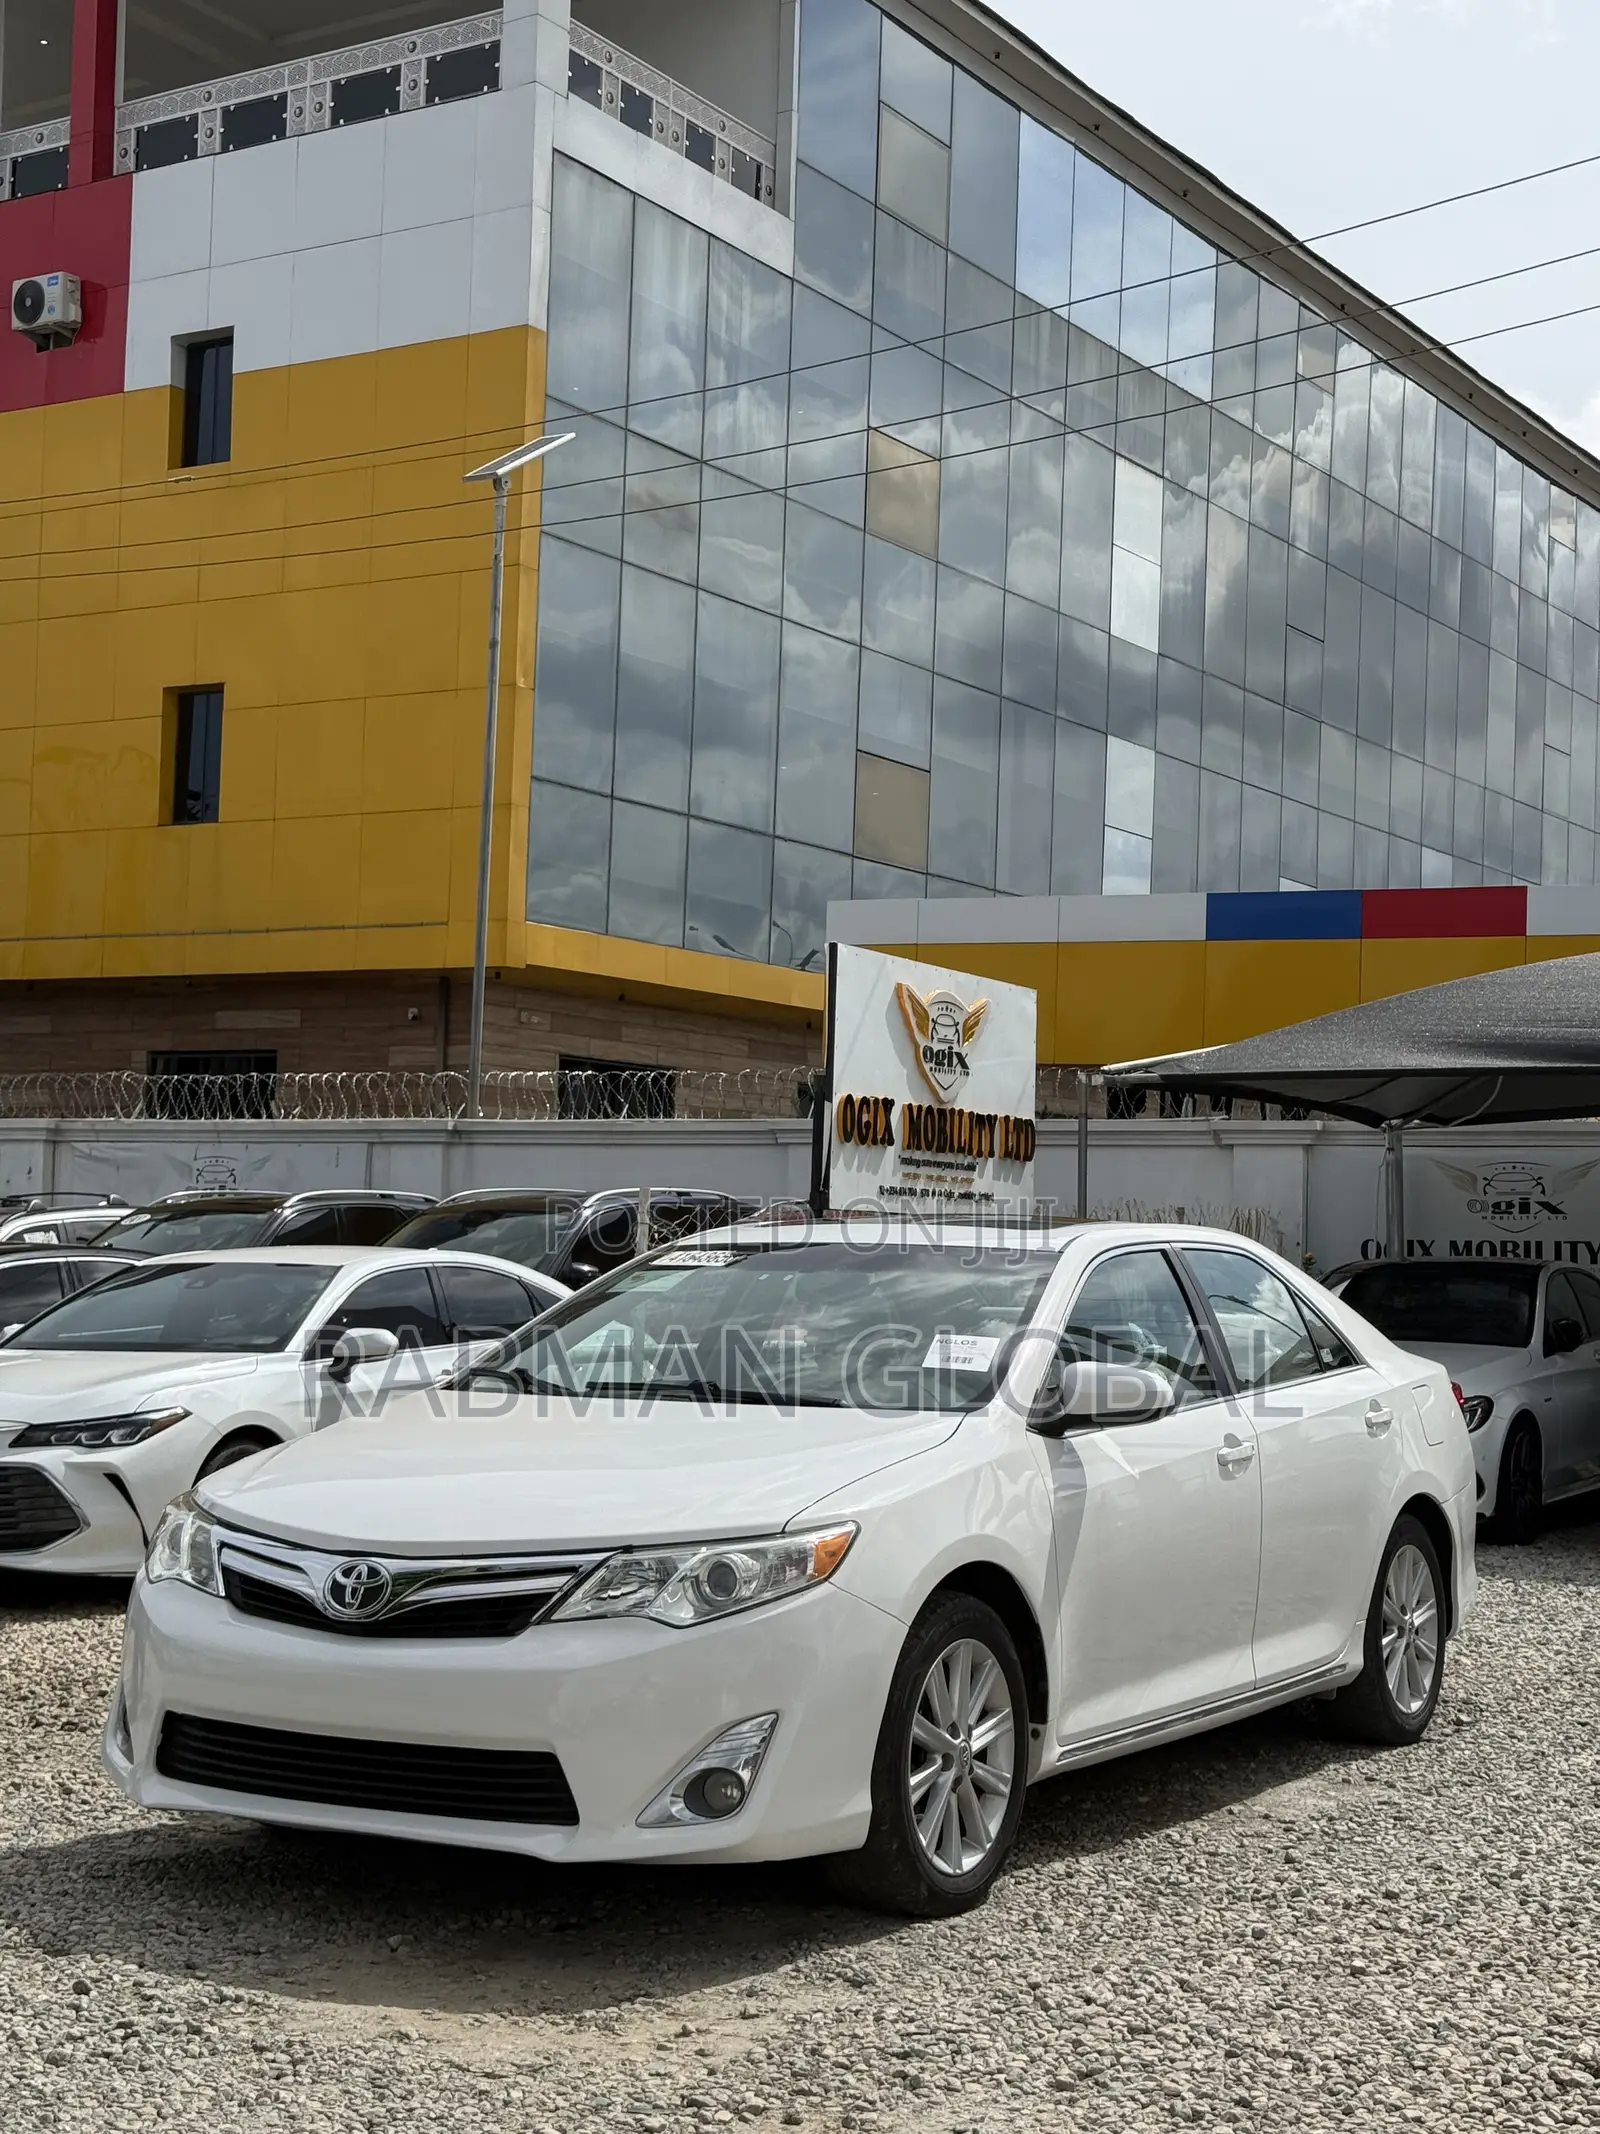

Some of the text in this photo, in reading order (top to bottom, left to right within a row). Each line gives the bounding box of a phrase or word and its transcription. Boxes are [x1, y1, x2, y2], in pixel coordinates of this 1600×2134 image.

[837, 1094, 1036, 1163] OGIX MOBILITY LTD
